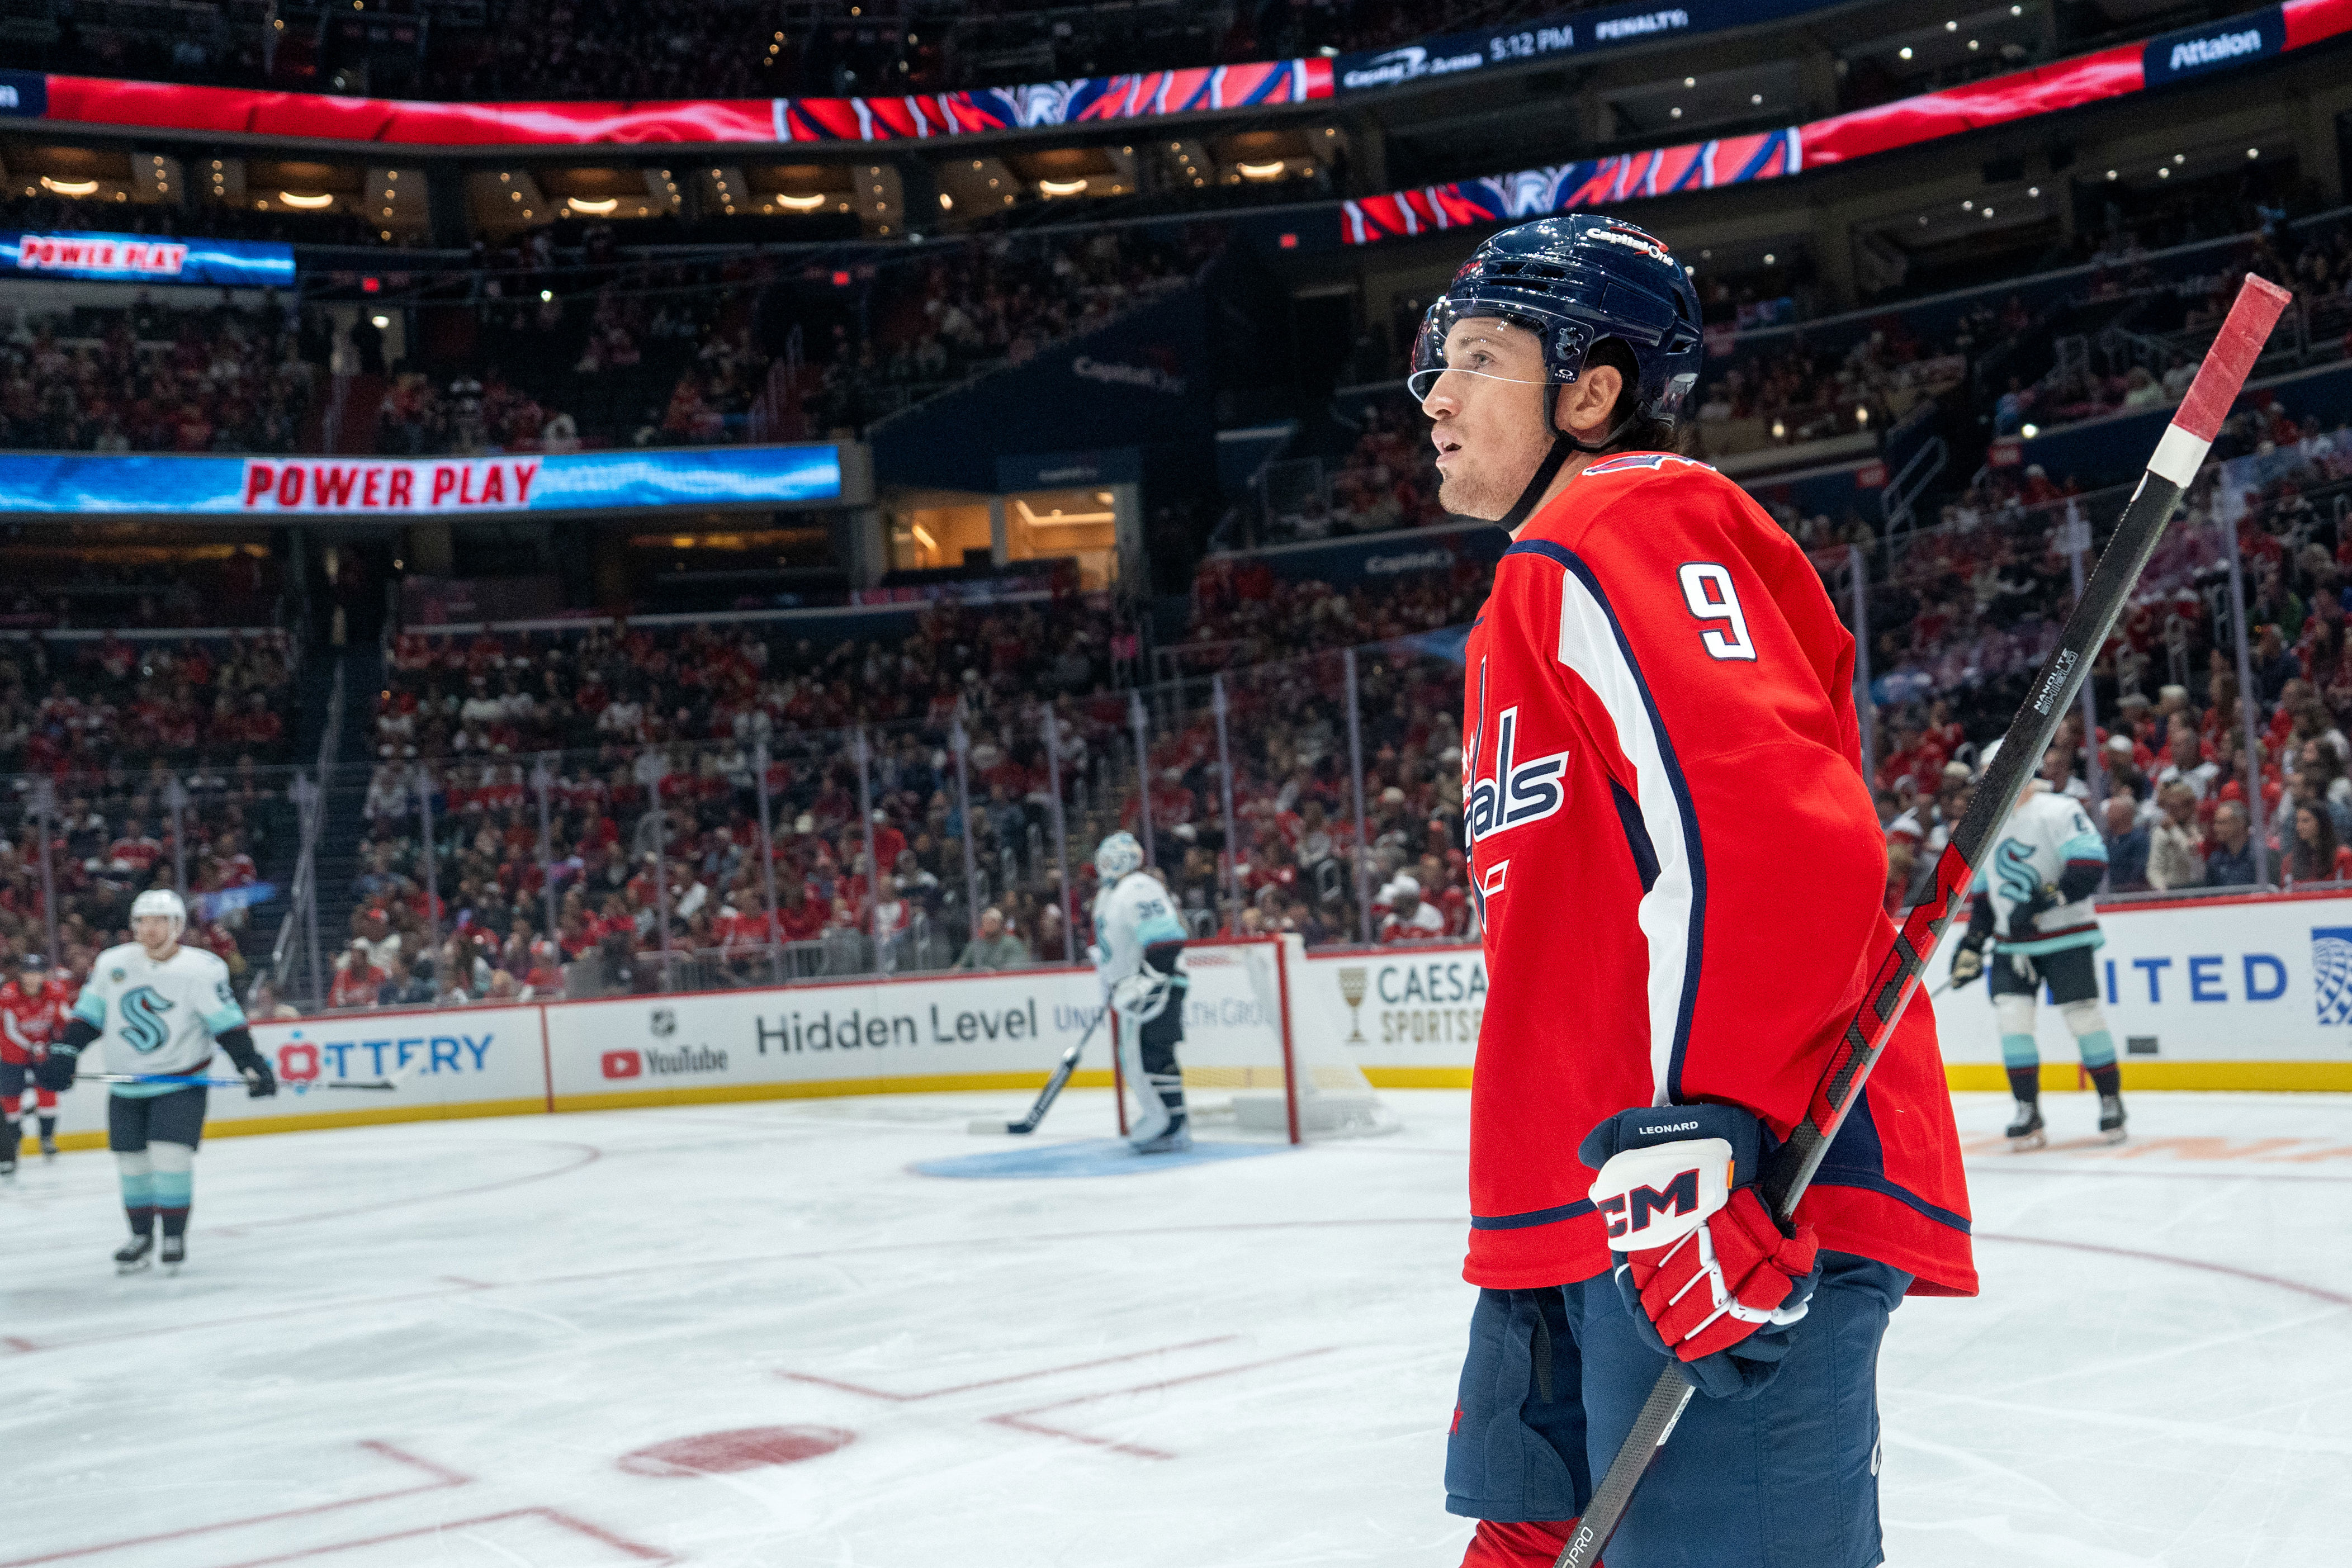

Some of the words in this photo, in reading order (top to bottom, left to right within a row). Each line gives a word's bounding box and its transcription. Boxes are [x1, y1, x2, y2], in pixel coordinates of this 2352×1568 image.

[1489, 32, 1535, 61] 5:12
[1537, 25, 1573, 52] PM
[2169, 29, 2262, 70] Attalon
[18, 235, 115, 271] POWER
[122, 241, 188, 275] PLAY
[243, 459, 416, 511] POWER
[429, 456, 541, 510] PLAY
[1676, 561, 1758, 662] 9
[2033, 647, 2069, 710] NANOLITE
[2039, 650, 2079, 716] SHIELD
[1377, 960, 1488, 1003] CAESA
[2104, 953, 2289, 1005] ITED
[756, 1009, 917, 1056] Hidden
[930, 996, 1039, 1045] Level
[1380, 1008, 1484, 1045] SPORTS
[277, 1034, 494, 1082] OTTERY
[644, 1042, 729, 1077] YouTube
[1639, 1120, 1699, 1135] LEONARD
[1597, 1168, 1700, 1239] CM
